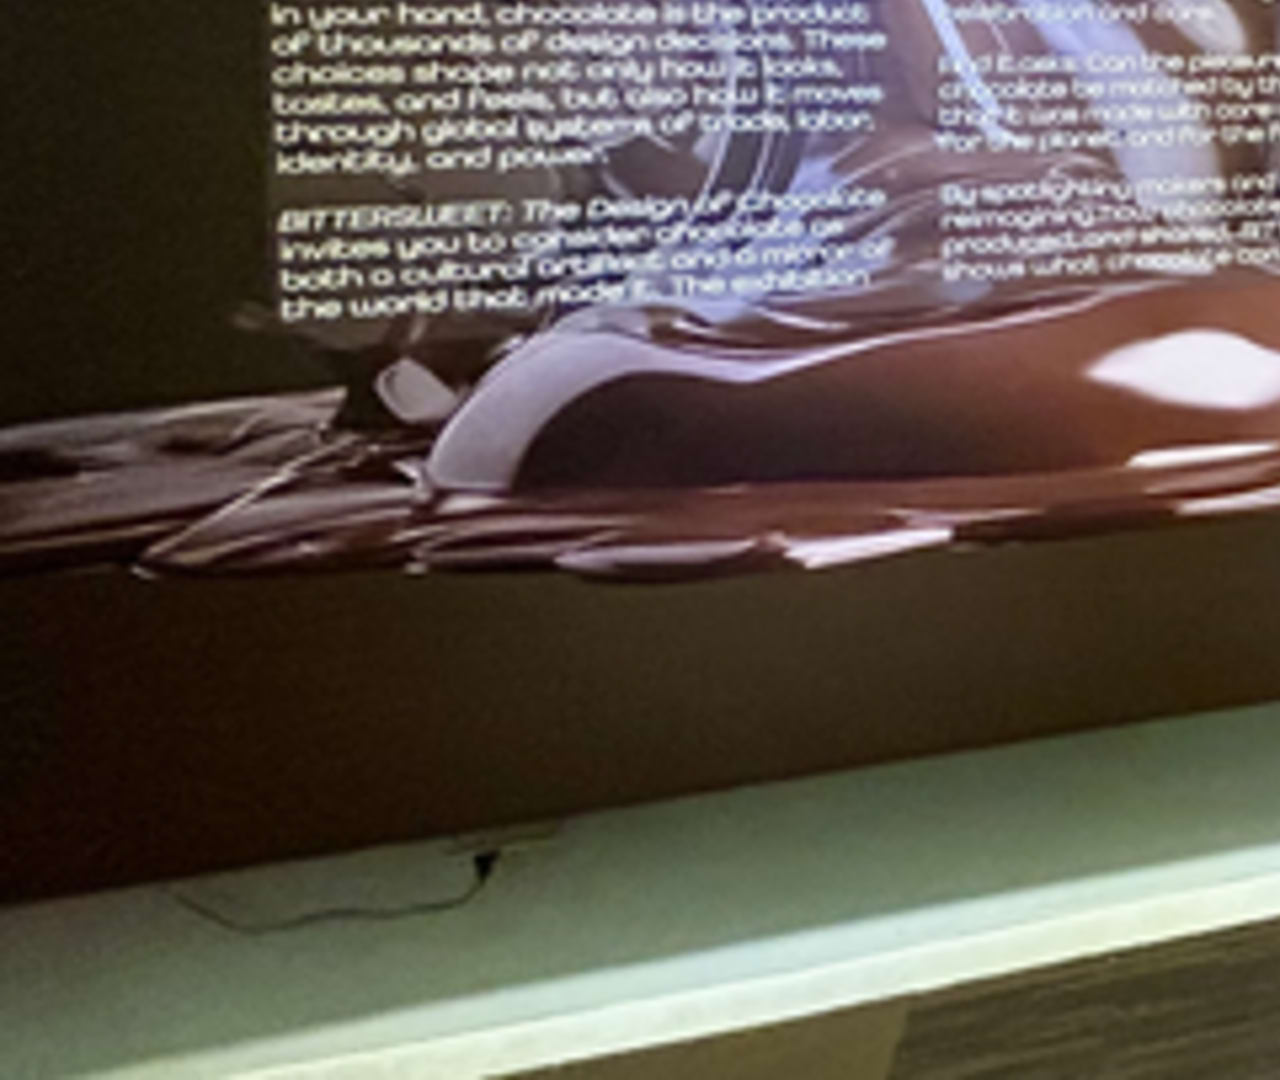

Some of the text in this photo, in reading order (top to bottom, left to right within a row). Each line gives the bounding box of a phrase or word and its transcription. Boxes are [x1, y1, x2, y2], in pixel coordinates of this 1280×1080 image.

[271, 4, 300, 25] in
[308, 7, 391, 31] your
[496, 3, 657, 25] chocolate
[664, 3, 687, 25] is
[693, 2, 746, 26] the
[751, 2, 870, 28] product
[271, 30, 312, 56] of
[318, 30, 494, 56] thousands
[501, 29, 540, 54] of
[546, 28, 648, 56] design
[804, 27, 887, 50] These
[273, 64, 405, 86] choices
[412, 62, 516, 88] shape
[522, 61, 580, 83] not
[586, 59, 651, 83] only
[660, 58, 724, 78] how
[396, 88, 460, 110] and
[562, 88, 620, 109] but
[626, 86, 689, 107] also
[693, 84, 758, 105] how
[765, 84, 787, 103] it
[793, 84, 883, 103] moves
[276, 120, 417, 147] through
[422, 115, 519, 146] global
[525, 114, 653, 142] systems
[660, 111, 695, 135] of
[426, 147, 491, 170] and
[521, 199, 582, 222] The
[586, 196, 688, 223] Design
[735, 188, 886, 213] Chocolate
[281, 237, 389, 261] invites
[396, 235, 460, 261] you
[467, 231, 506, 253] to
[281, 267, 363, 292] both
[370, 268, 395, 287] a
[401, 255, 530, 285] cultural
[671, 246, 731, 269] and
[281, 295, 343, 321] the
[350, 288, 449, 319] world
[454, 287, 526, 311] that
